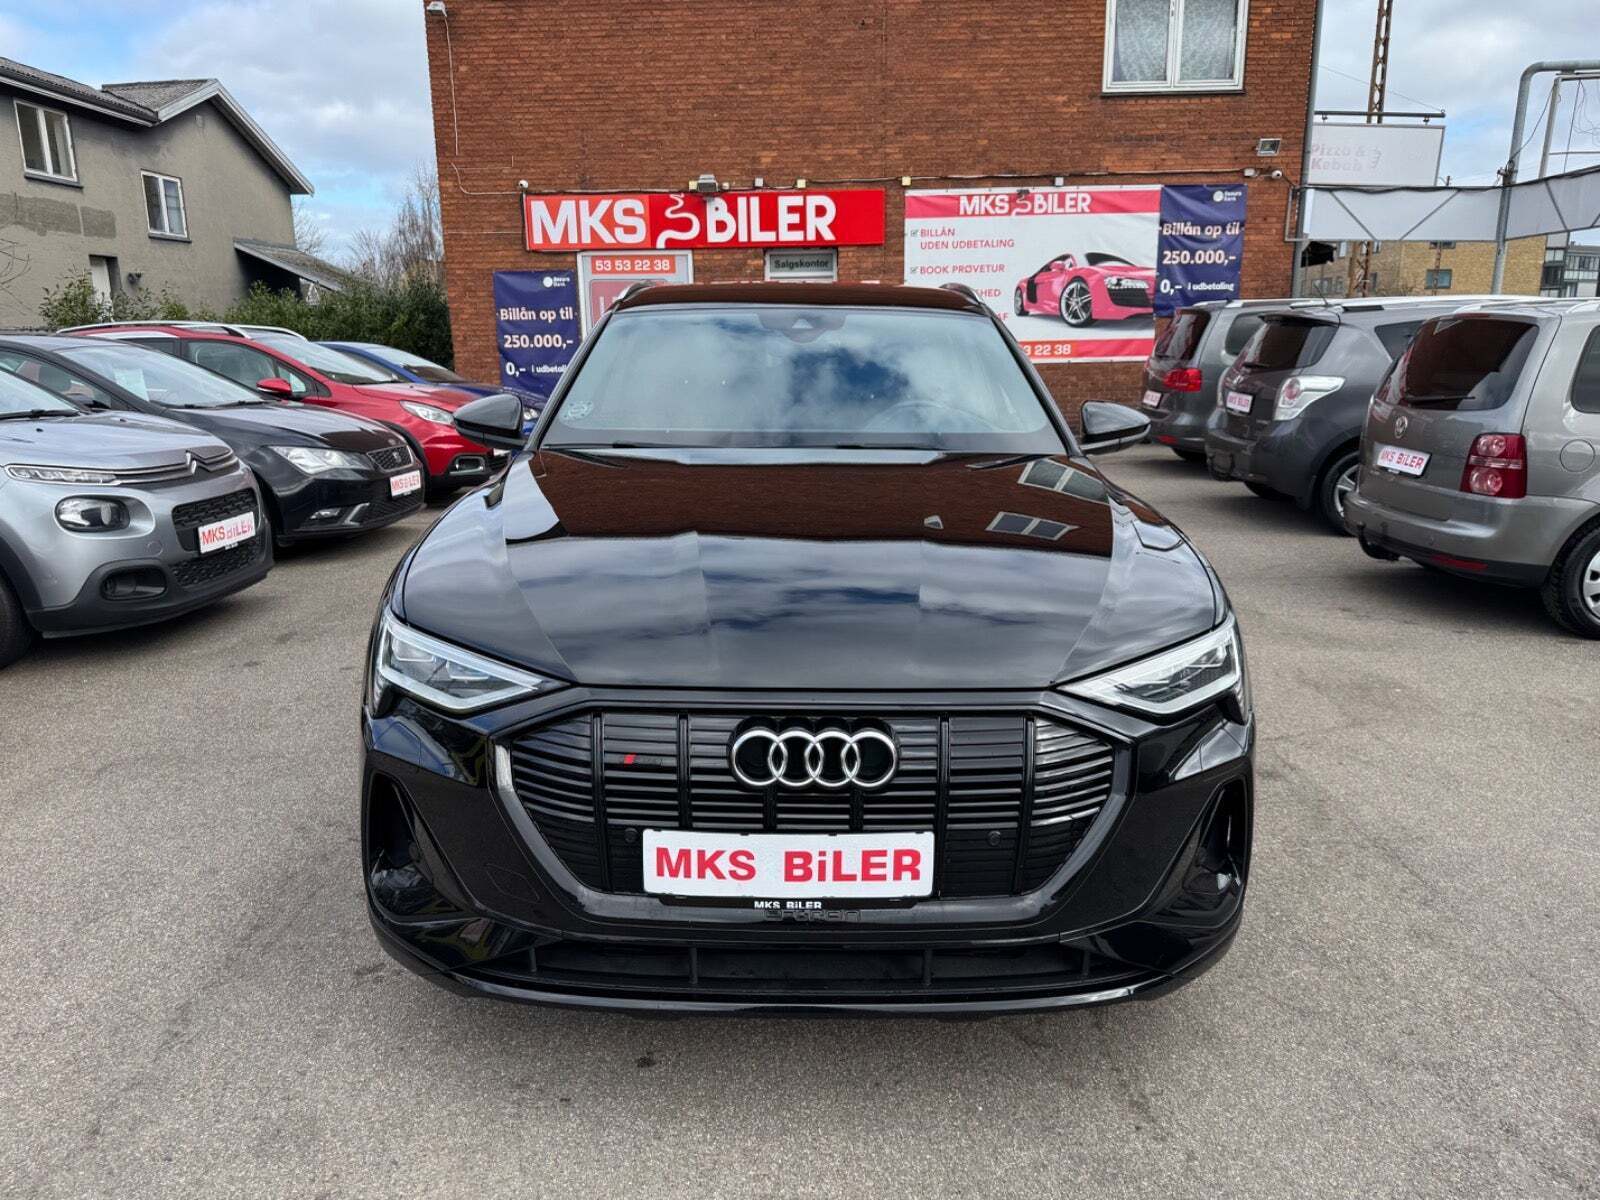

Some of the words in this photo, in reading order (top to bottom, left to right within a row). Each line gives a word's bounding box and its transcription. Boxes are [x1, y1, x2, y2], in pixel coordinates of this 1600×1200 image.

[959, 194, 1009, 216] MKS
[1033, 192, 1091, 214] BILER
[530, 198, 647, 245] MKS
[706, 195, 837, 243] BILER
[920, 228, 956, 238] BILLÅN
[1162, 222, 1201, 236] Billån
[1204, 226, 1222, 239] op
[1225, 221, 1240, 235] til
[920, 241, 949, 250] UDEN
[951, 239, 1015, 249] UDBETALING
[595, 259, 612, 271] 53
[614, 259, 632, 271] 53
[634, 259, 651, 271] 22
[654, 259, 671, 271] 38
[774, 259, 829, 270] Salgskontor
[1162, 250, 1236, 266] 250.000,-
[920, 266, 949, 275] BOOK
[952, 264, 1005, 274] PRØVETUR
[1160, 279, 1182, 296] 0,-
[1192, 281, 1234, 292] udbetaling
[500, 307, 536, 321] Billån
[539, 311, 557, 324] op
[559, 306, 574, 320] til
[503, 334, 574, 350] 250.000,-
[1034, 345, 1052, 356] 22
[1054, 344, 1072, 355] 38
[505, 361, 527, 377] 0,-
[201, 526, 226, 545] MKS
[655, 846, 756, 881] MKS
[784, 848, 922, 882] BiLER
[753, 900, 781, 909] MKS
[786, 900, 823, 909] BiLER
